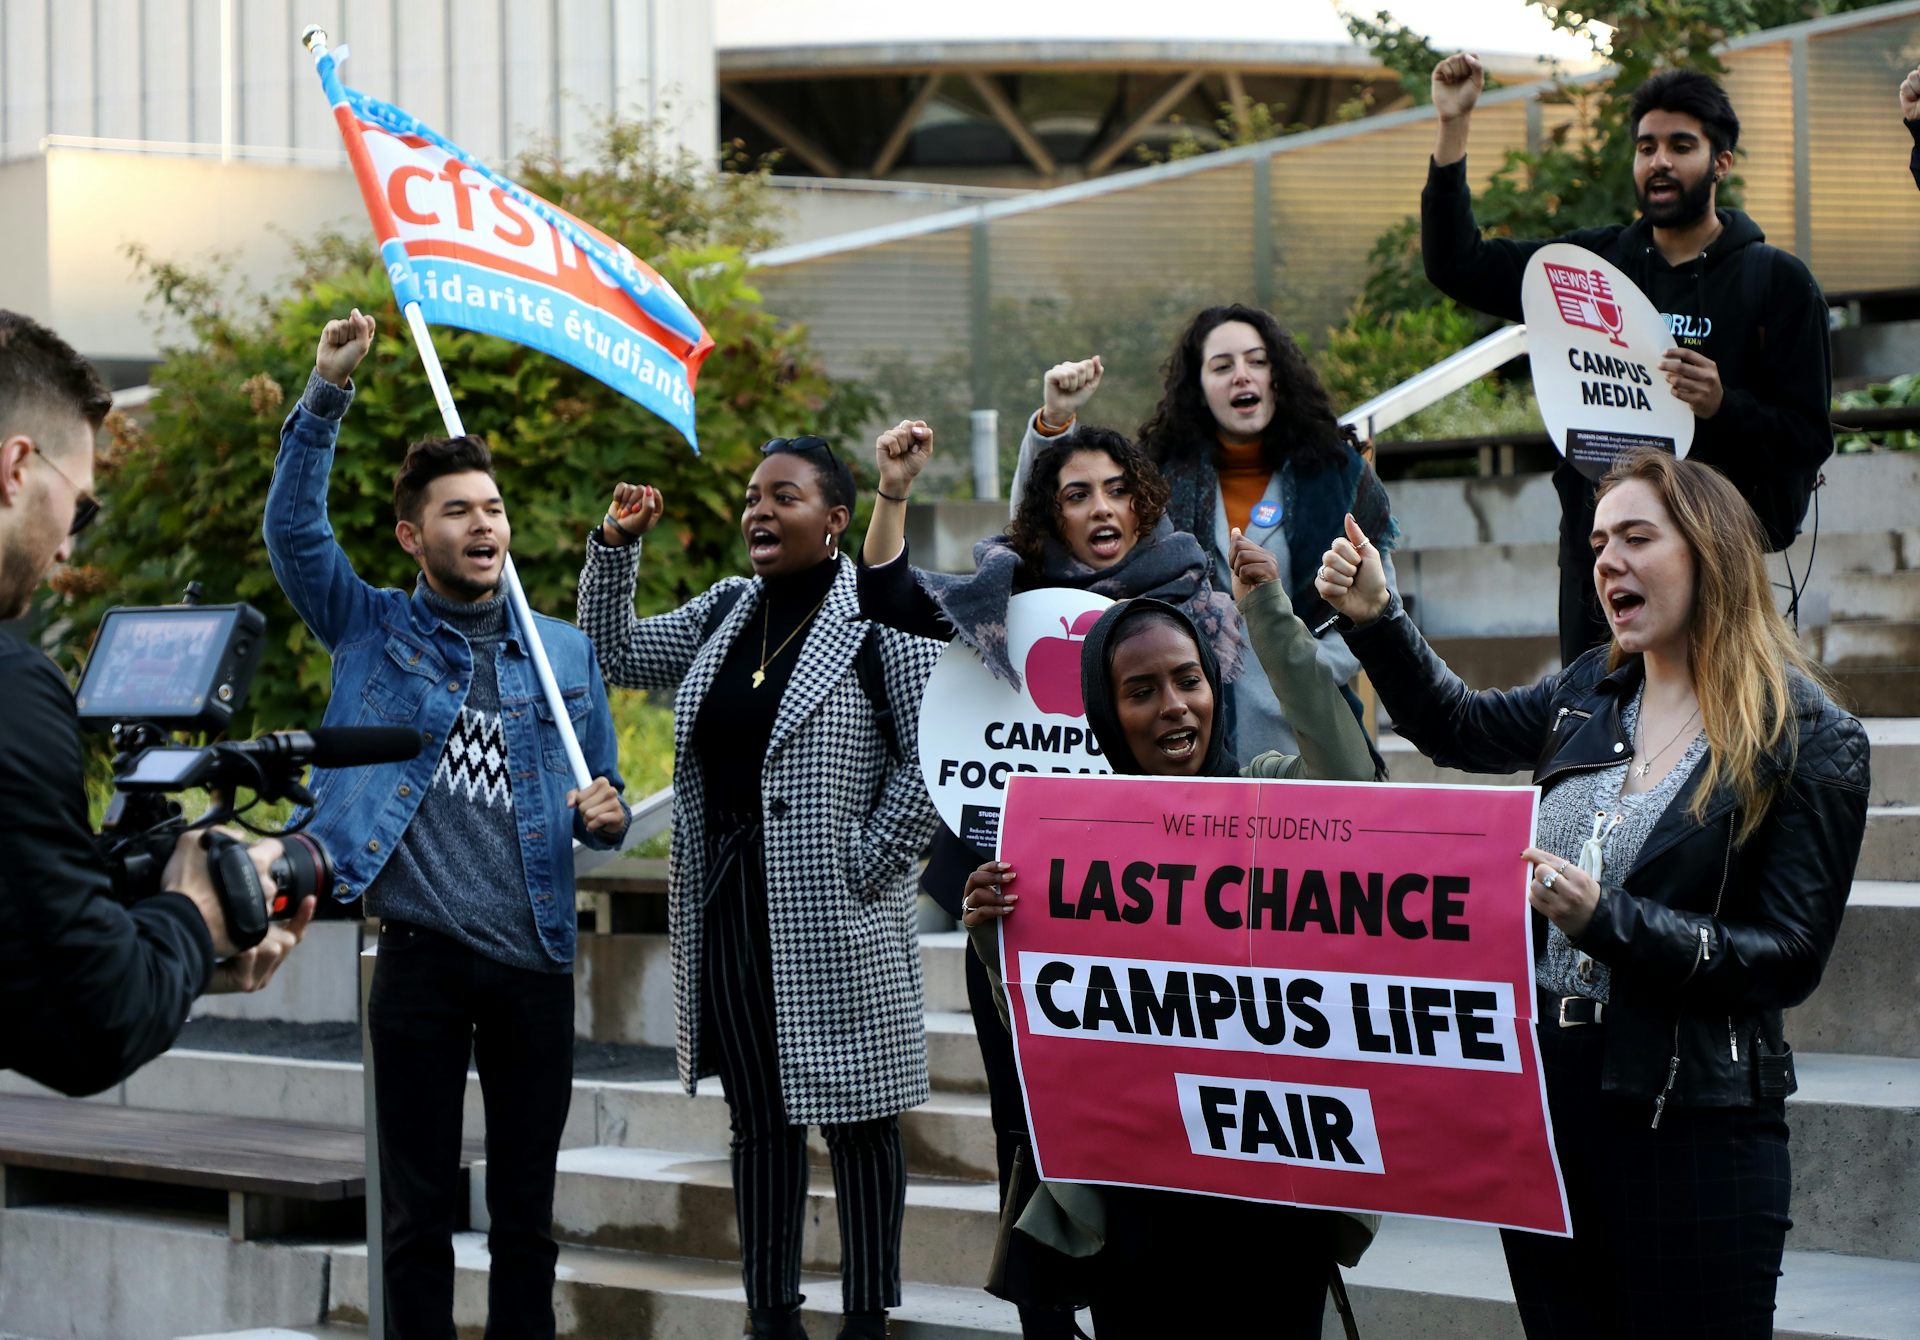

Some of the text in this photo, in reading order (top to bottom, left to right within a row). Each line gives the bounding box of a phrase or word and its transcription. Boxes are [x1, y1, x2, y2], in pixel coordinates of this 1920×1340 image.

[1548, 267, 1589, 291] NEWS
[410, 270, 554, 329] lidarité
[1568, 347, 1653, 386] CAMPUS
[1581, 381, 1653, 412] MEDIA
[984, 721, 1102, 757] CAMPU
[1162, 813, 1352, 843] WE THE STUDENTS
[1048, 858, 1471, 943] LAST CHANCE
[1035, 961, 1506, 1063] CAMPUS LIFE
[1198, 1085, 1366, 1165] FAIR
